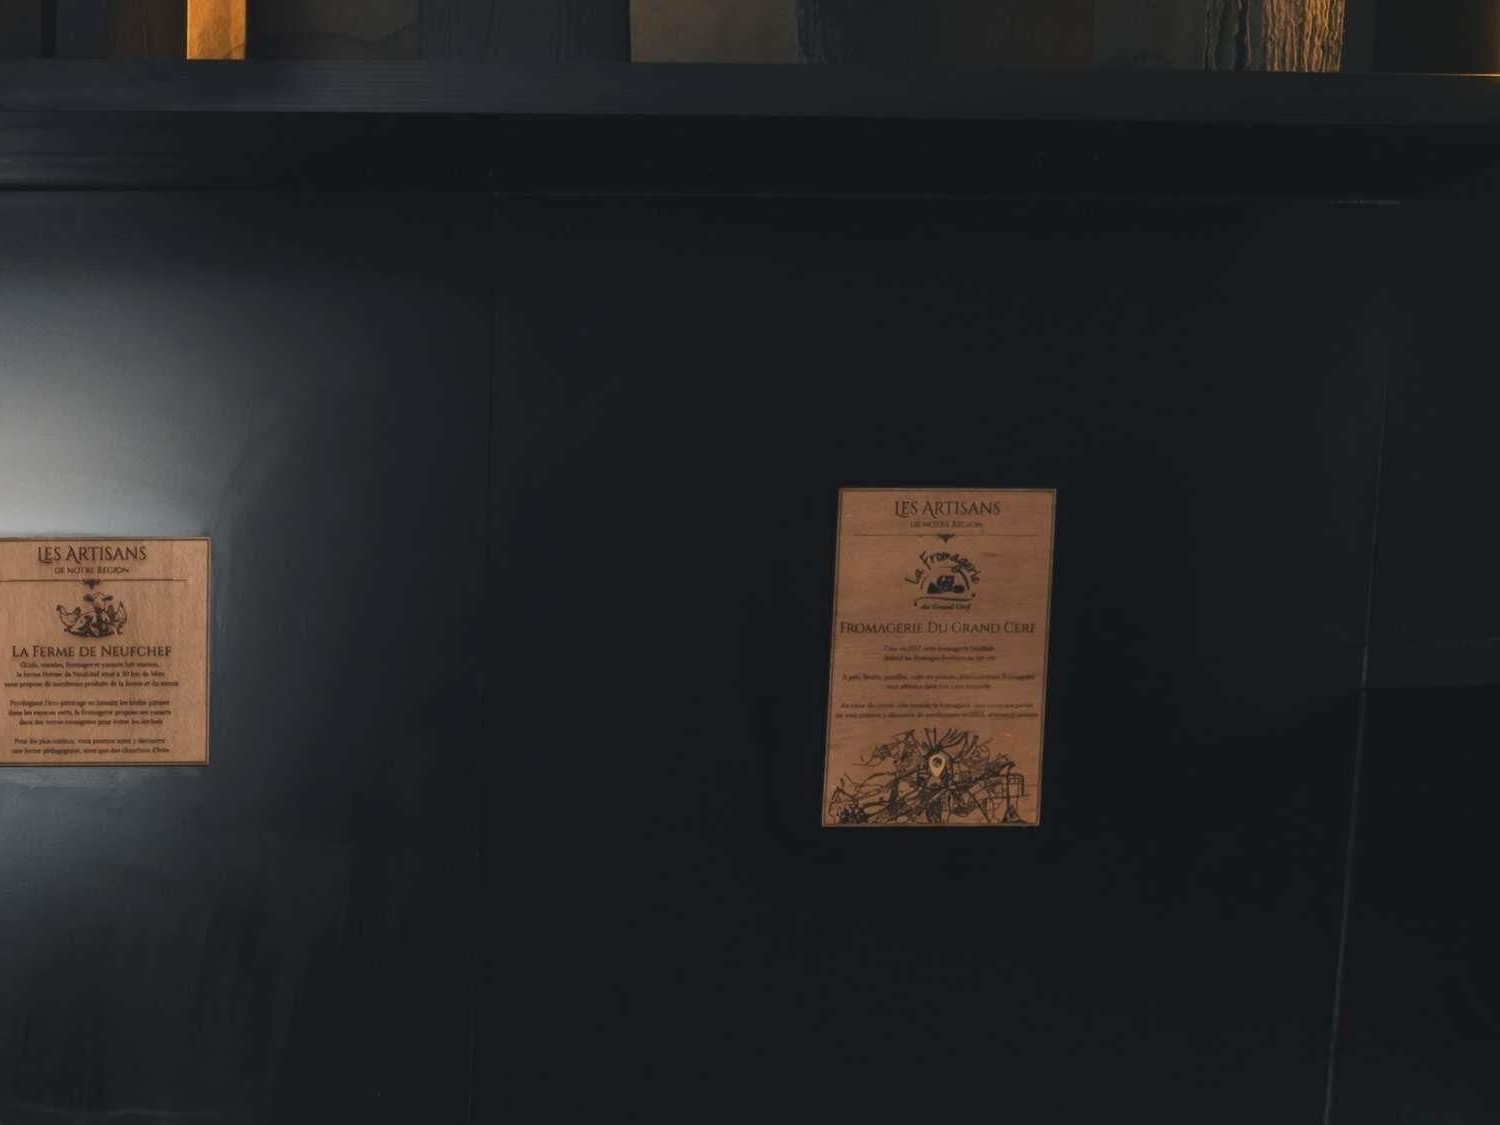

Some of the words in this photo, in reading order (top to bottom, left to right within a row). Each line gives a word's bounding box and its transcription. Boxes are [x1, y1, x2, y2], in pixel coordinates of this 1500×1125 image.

[894, 500, 918, 518] LES
[922, 500, 1001, 519] ARTISANS
[37, 546, 61, 563] LES
[65, 546, 147, 563] ARTISANS
[54, 566, 64, 574] DE
[67, 566, 94, 574] NOTRE
[839, 621, 924, 634] FROMAGERIE
[928, 621, 947, 633] DU
[951, 621, 1000, 634] GRAND
[12, 645, 29, 658] LA
[33, 645, 75, 657] FERME
[79, 645, 97, 657] DE
[100, 644, 172, 657] NEUFCHEF
